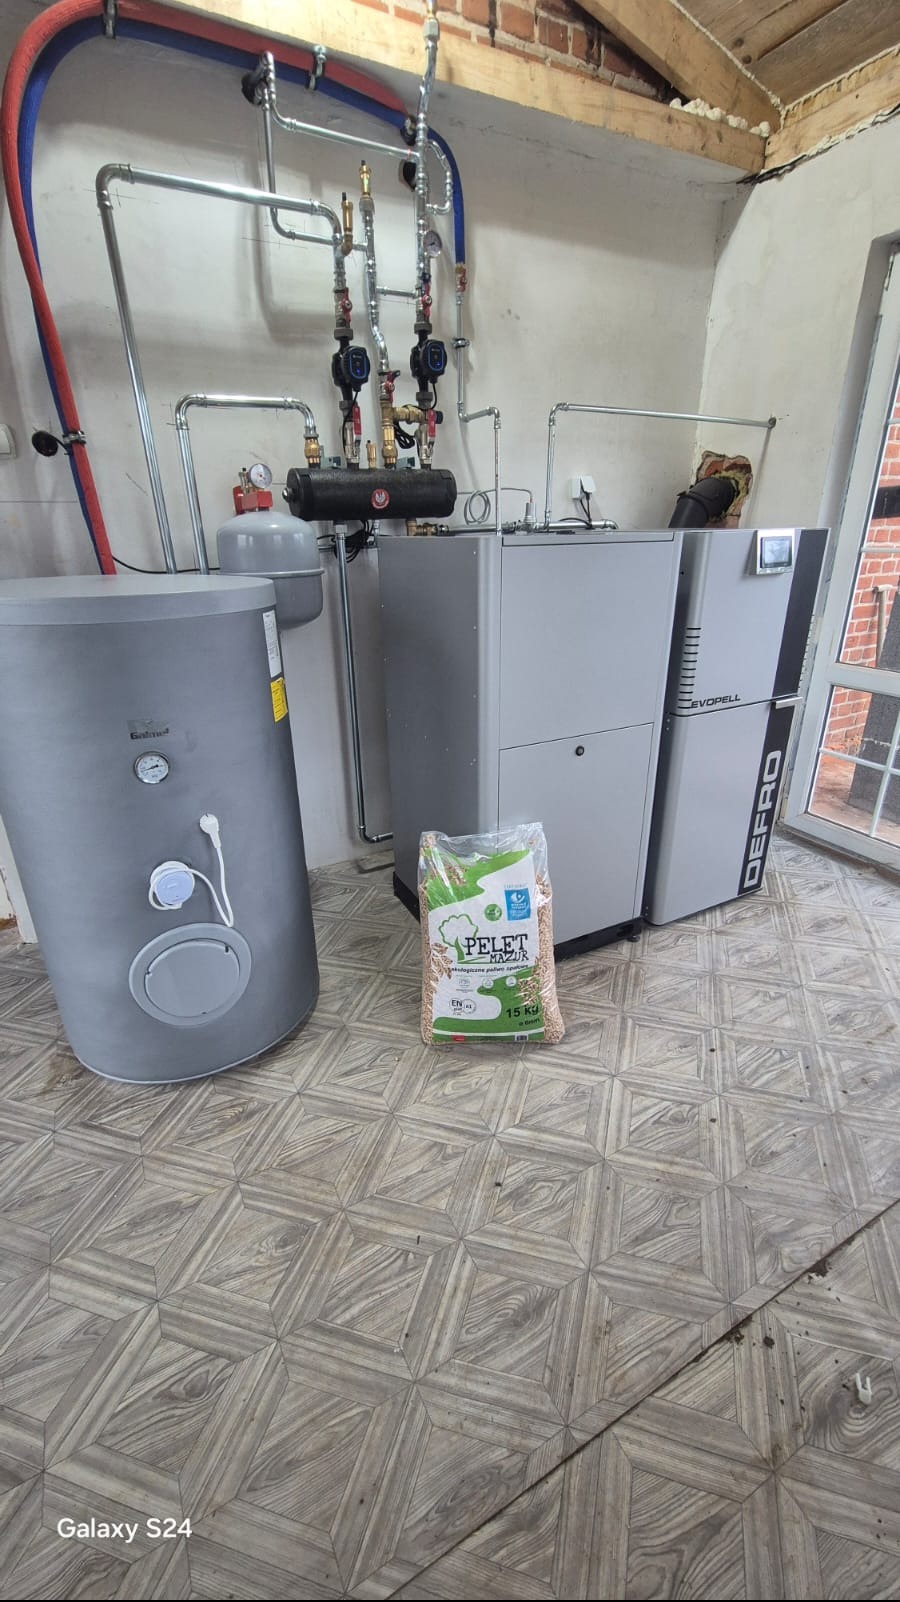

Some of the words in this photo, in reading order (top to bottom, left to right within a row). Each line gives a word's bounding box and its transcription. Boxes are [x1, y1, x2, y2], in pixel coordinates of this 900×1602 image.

[691, 694, 741, 709] EVOPELL
[743, 750, 782, 888] DEFRO
[465, 934, 528, 956] PELET
[489, 950, 529, 964] MAZUR
[451, 999, 463, 1007] EN
[506, 1007, 521, 1018] 15
[524, 1003, 539, 1016] kg
